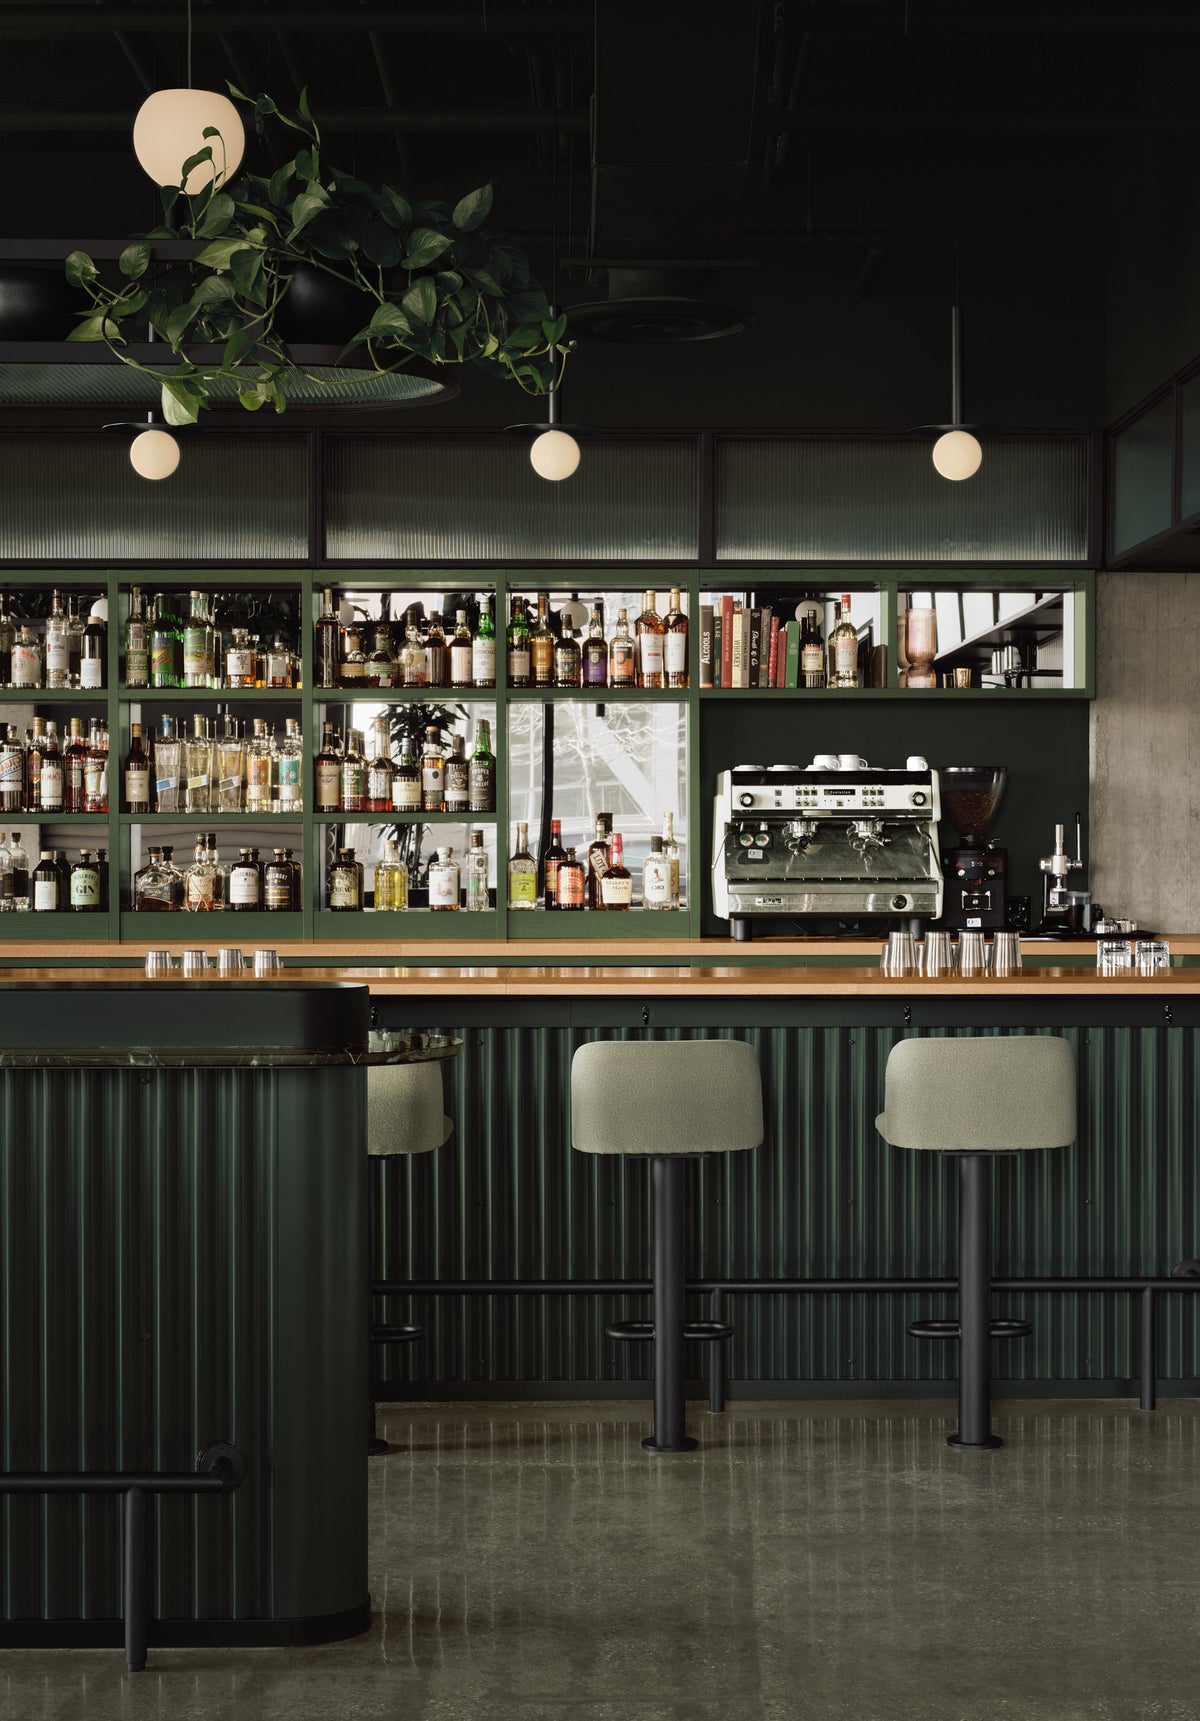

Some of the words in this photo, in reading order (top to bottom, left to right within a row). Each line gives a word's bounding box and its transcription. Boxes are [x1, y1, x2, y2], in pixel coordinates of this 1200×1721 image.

[701, 631, 711, 664] ALCOOLS
[733, 639, 741, 668] WHISKEY
[593, 854, 605, 868] LOT
[75, 885, 95, 894] GIN
